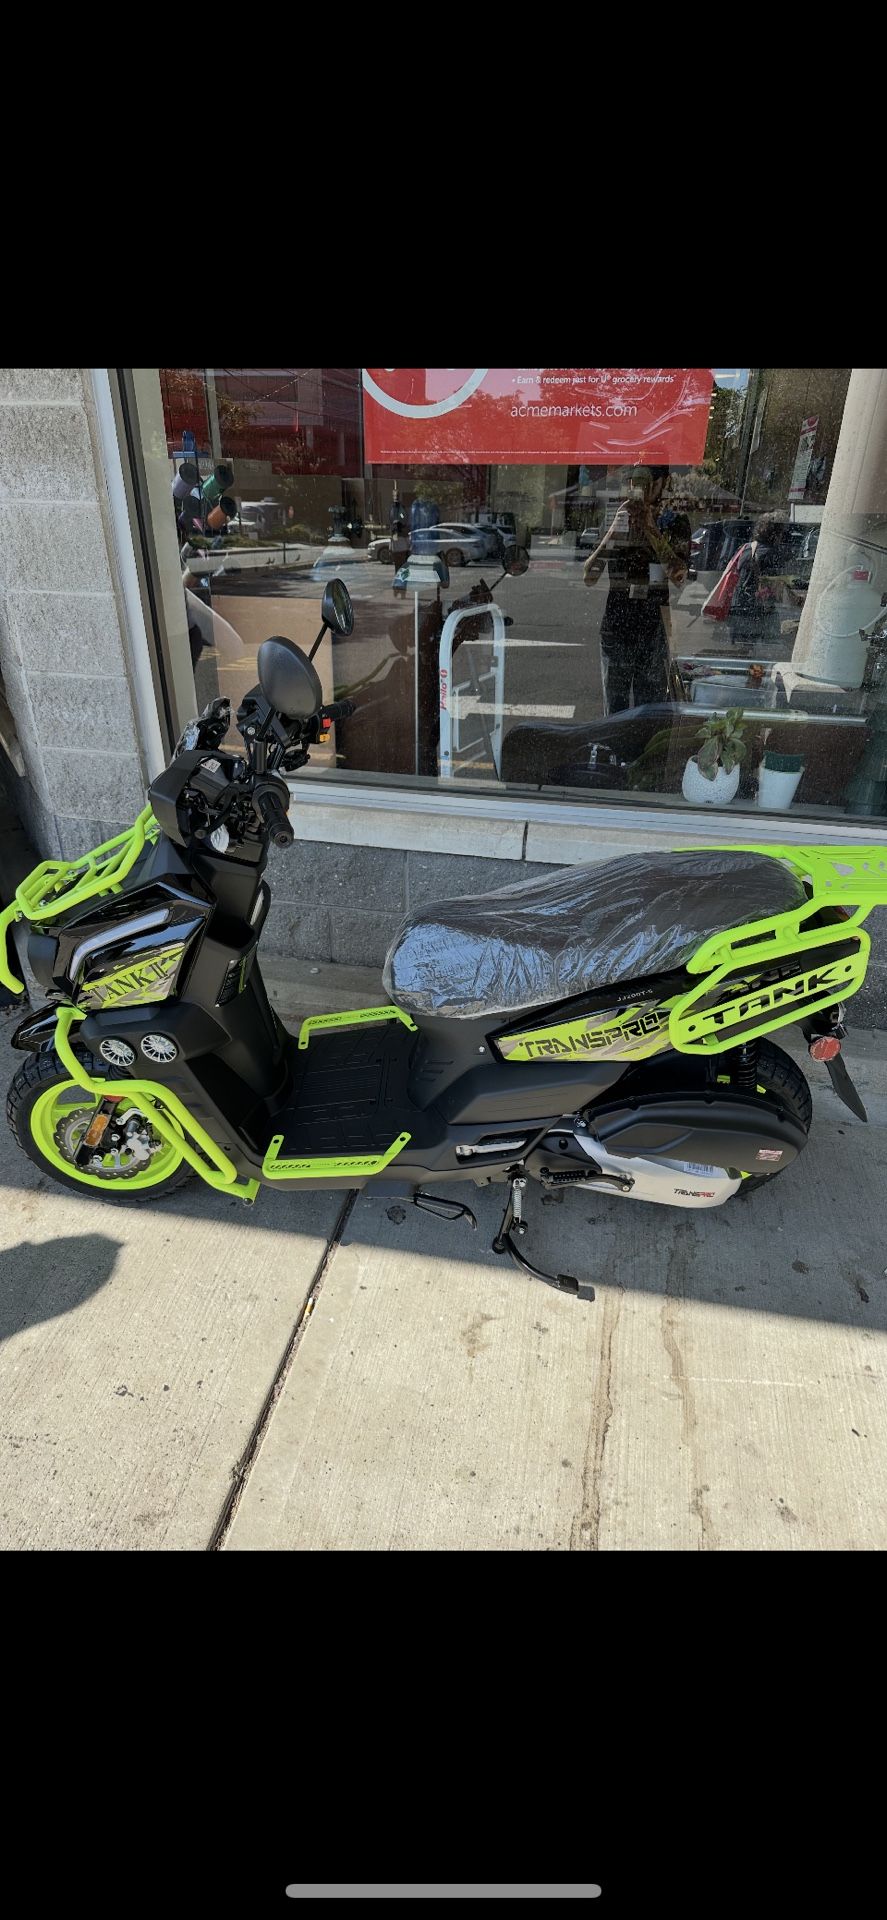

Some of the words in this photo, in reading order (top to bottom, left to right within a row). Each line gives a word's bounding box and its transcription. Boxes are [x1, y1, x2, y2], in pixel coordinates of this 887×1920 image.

[517, 376, 534, 384] Earn
[536, 376, 541, 384] &
[543, 376, 571, 384] redeem
[572, 376, 586, 386] just
[588, 375, 600, 383] for
[612, 376, 641, 385] grocery
[510, 404, 638, 418] acmemarkets.com
[89, 968, 155, 1003] TANK
[702, 967, 839, 1024] TANK
[518, 1011, 662, 1058] TRANSPRO
